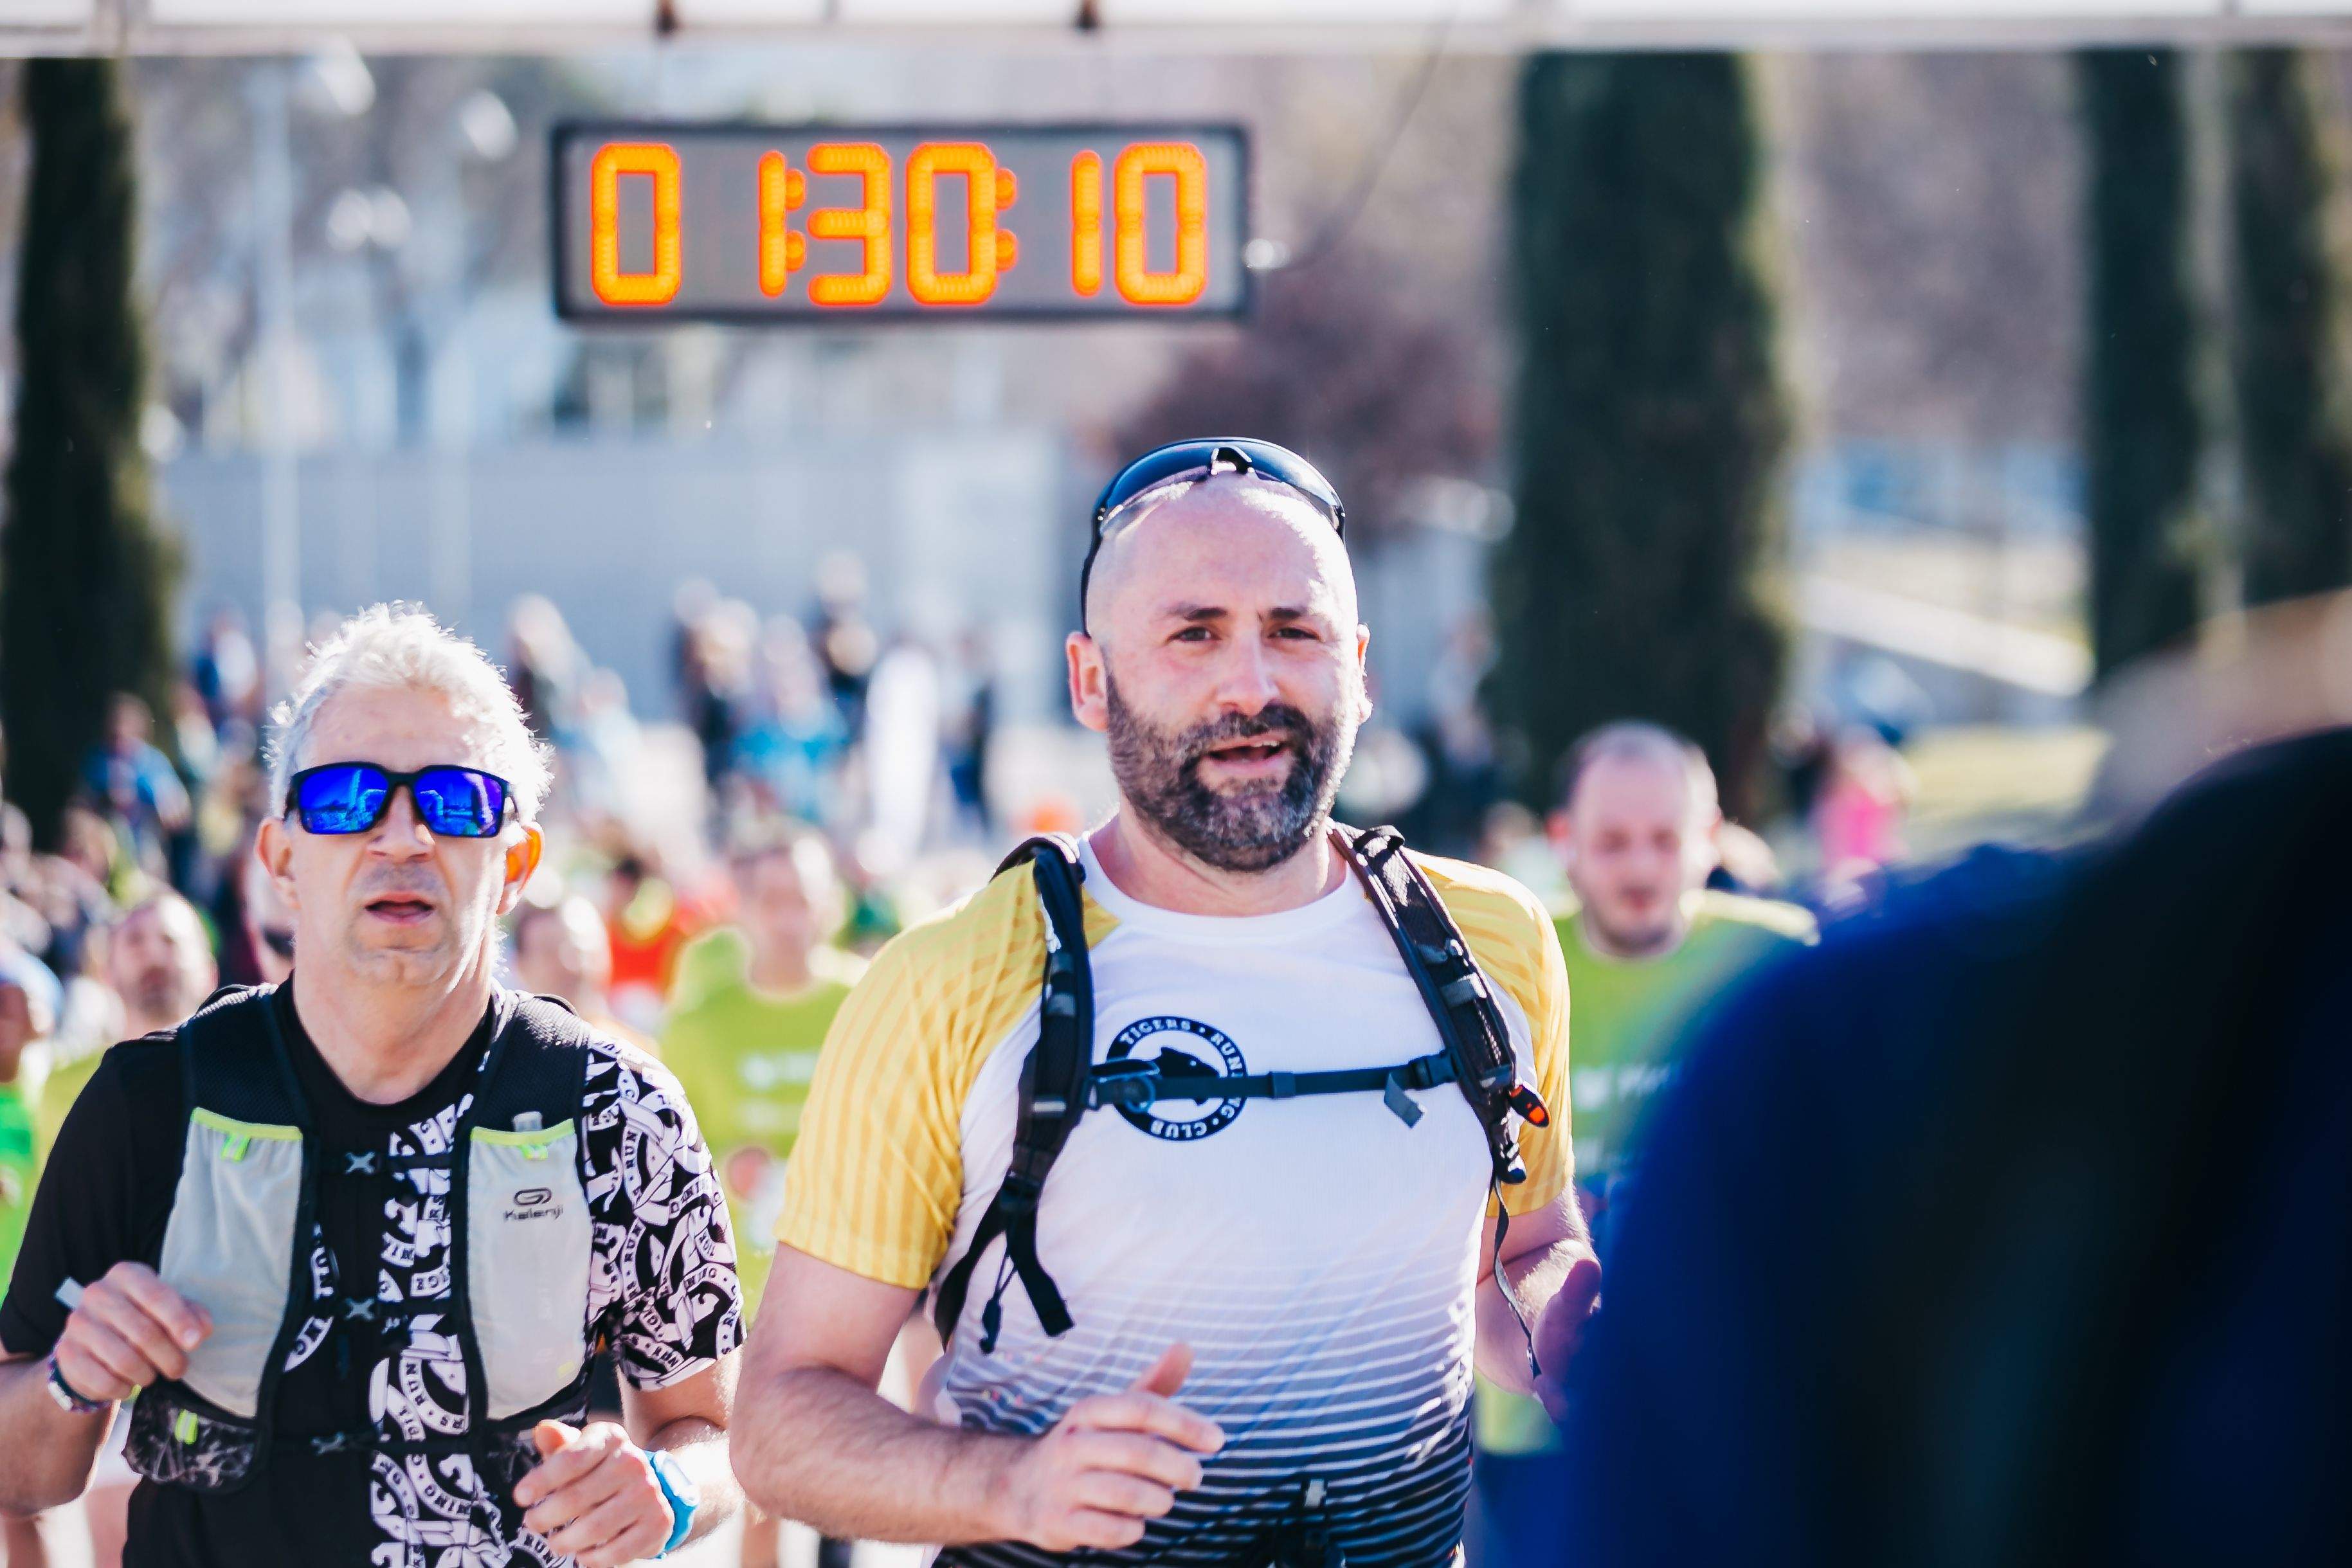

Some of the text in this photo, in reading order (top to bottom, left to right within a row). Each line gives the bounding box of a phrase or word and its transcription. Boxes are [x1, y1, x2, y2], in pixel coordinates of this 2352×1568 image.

[1119, 1018, 1191, 1045] TIGERS
[1150, 1121, 1208, 1139] CLUB
[503, 1204, 563, 1221] Kalenji
